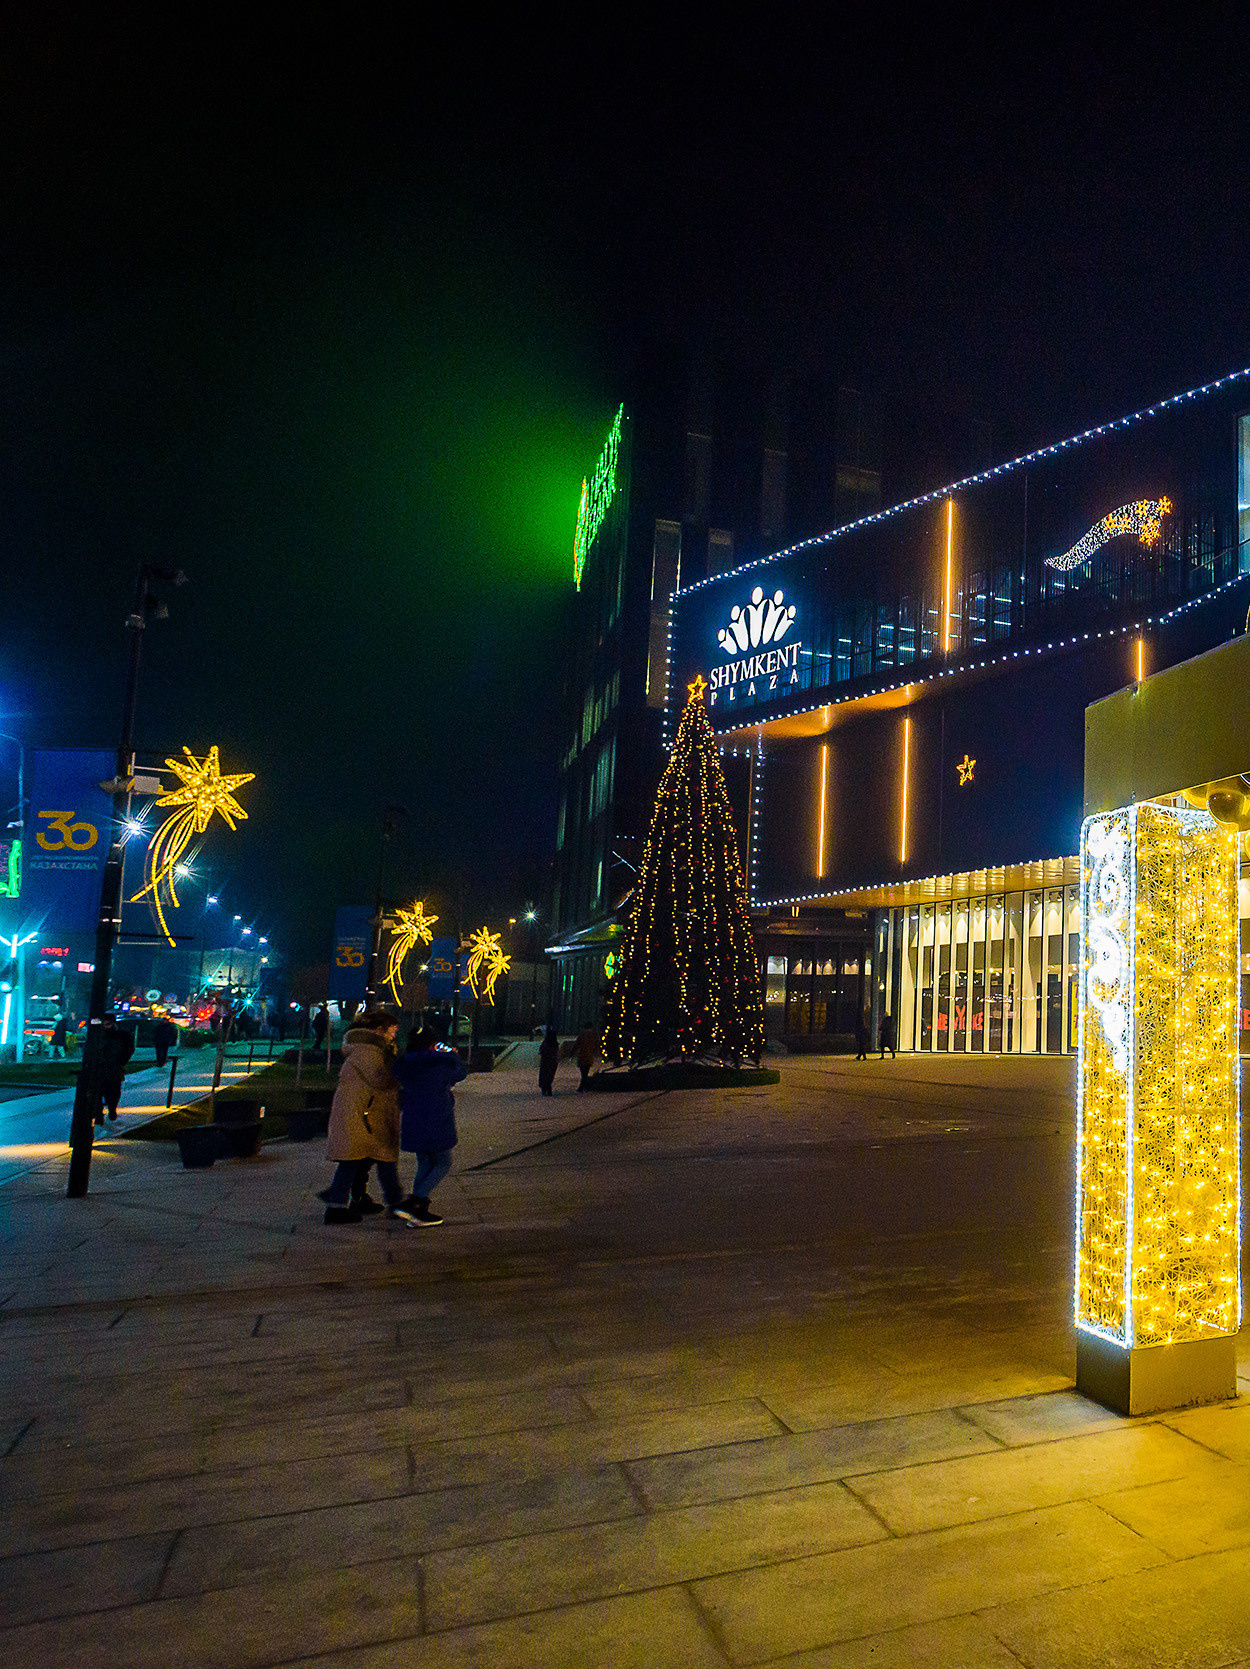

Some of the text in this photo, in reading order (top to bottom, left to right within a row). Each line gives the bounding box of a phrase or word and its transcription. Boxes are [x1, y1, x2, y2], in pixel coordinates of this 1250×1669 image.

[710, 641, 802, 690] SHYMKENT
[710, 669, 799, 706] PLAZA
[36, 810, 99, 851] 30
[336, 946, 365, 967] 30
[433, 958, 453, 972] 30
